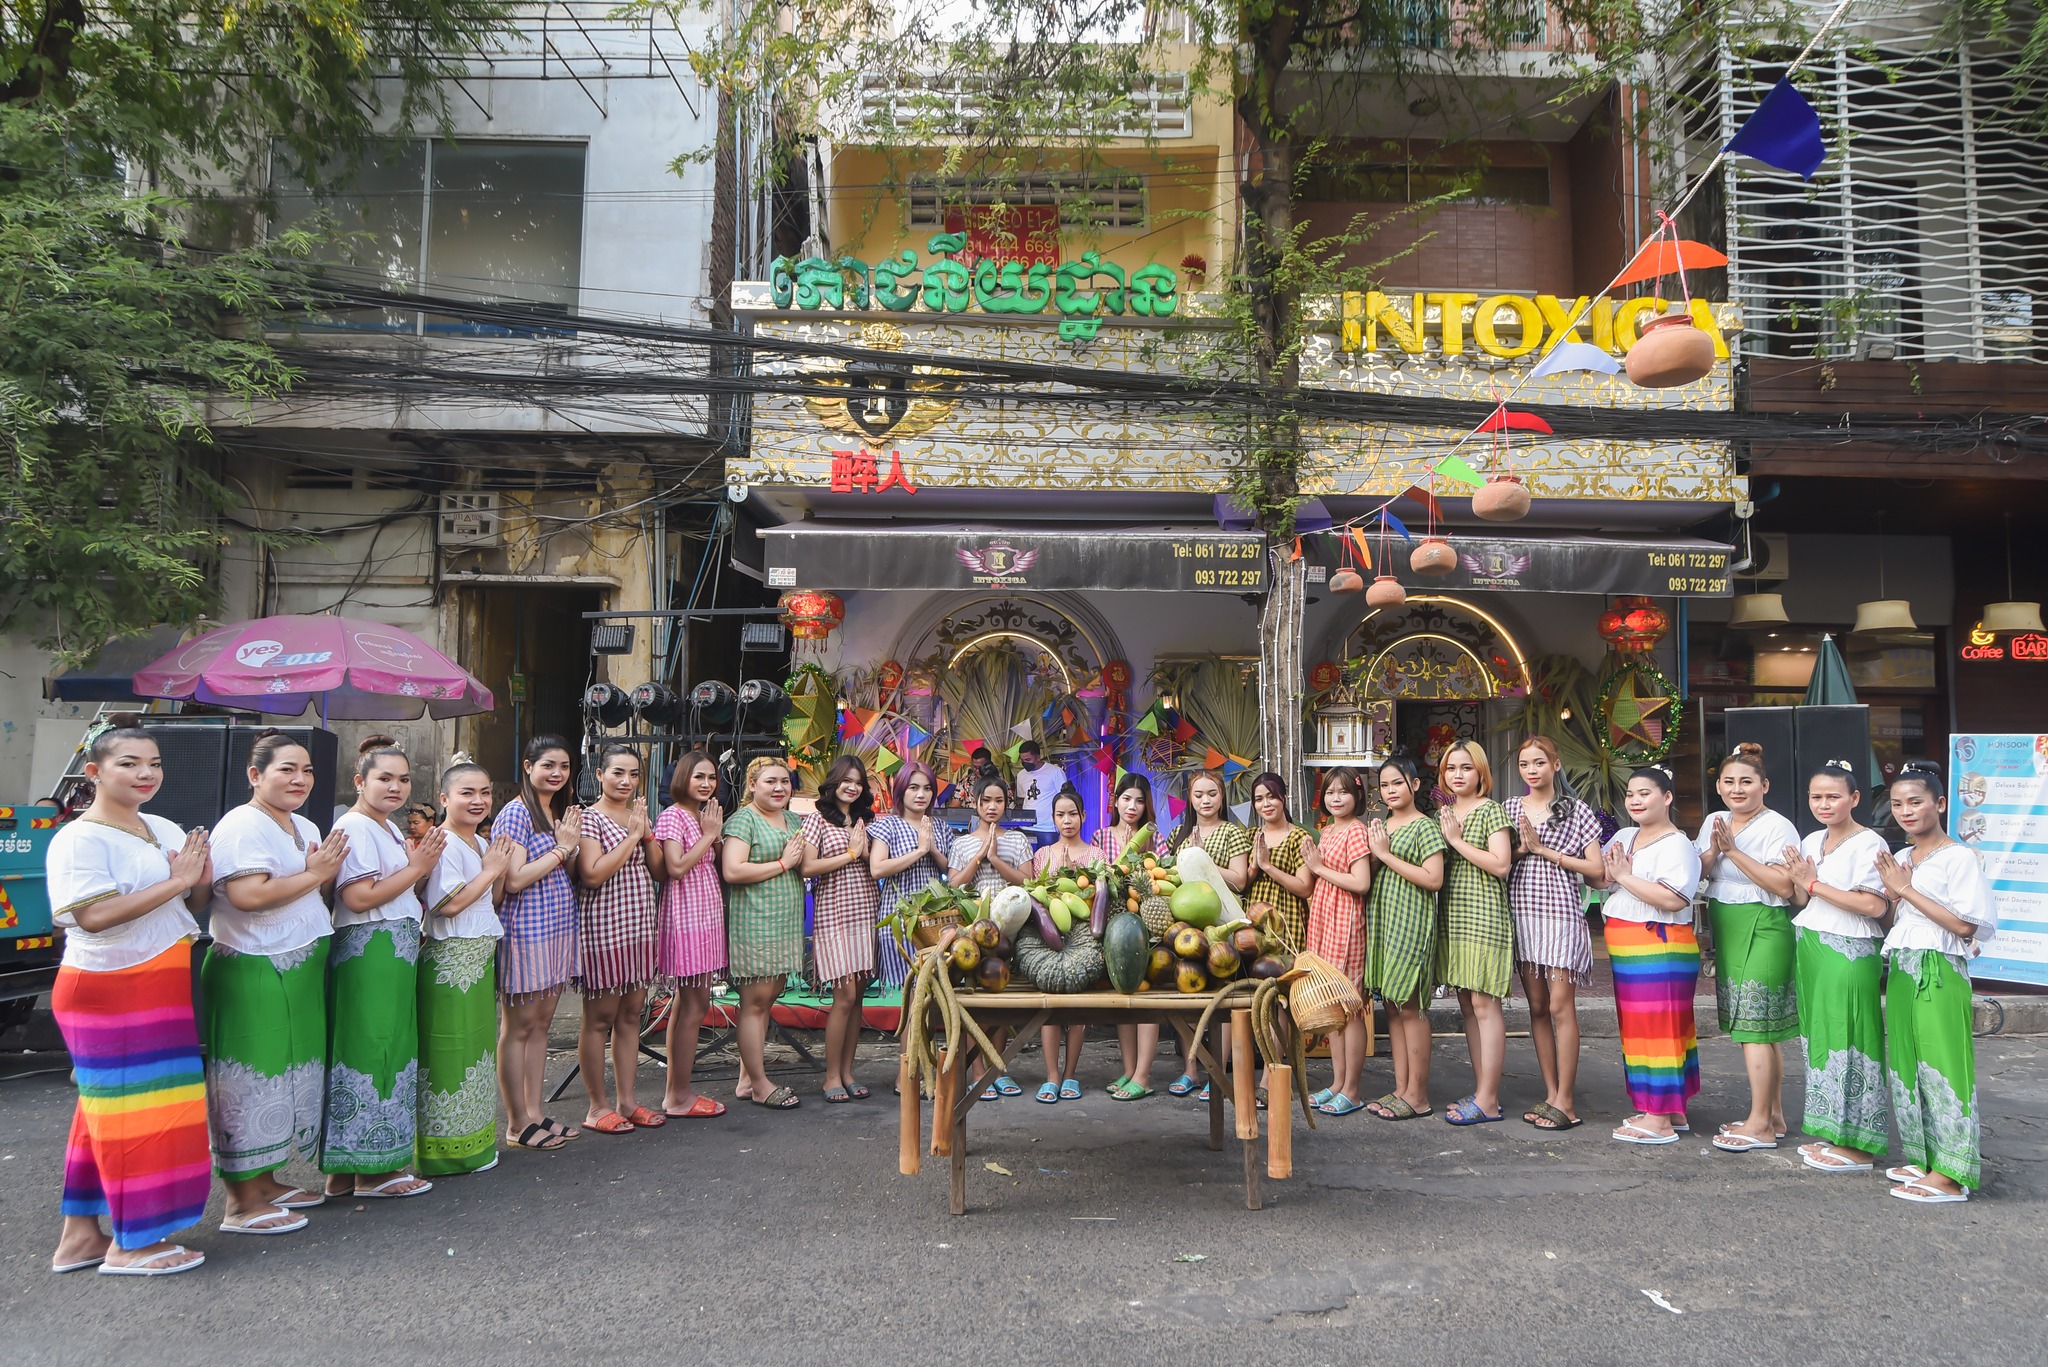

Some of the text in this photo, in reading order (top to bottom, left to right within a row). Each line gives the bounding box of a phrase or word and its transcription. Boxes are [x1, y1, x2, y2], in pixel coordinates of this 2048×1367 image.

[1025, 240, 1054, 253] 669
[831, 449, 918, 495] 醉人
[1172, 543, 1261, 558] Tel: 061 722 297
[1648, 552, 1726, 568] Tel: 061 722 297
[1195, 570, 1261, 585] 093 722 297
[1668, 577, 1727, 592] 093 722 297
[240, 644, 282, 660] yes
[1961, 645, 2004, 660] Coffee
[2015, 640, 2048, 656] BAR
[1988, 741, 2029, 749] MONSOON
[2011, 896, 2042, 905] Dormitory
[2011, 936, 2042, 946] Dormitory
